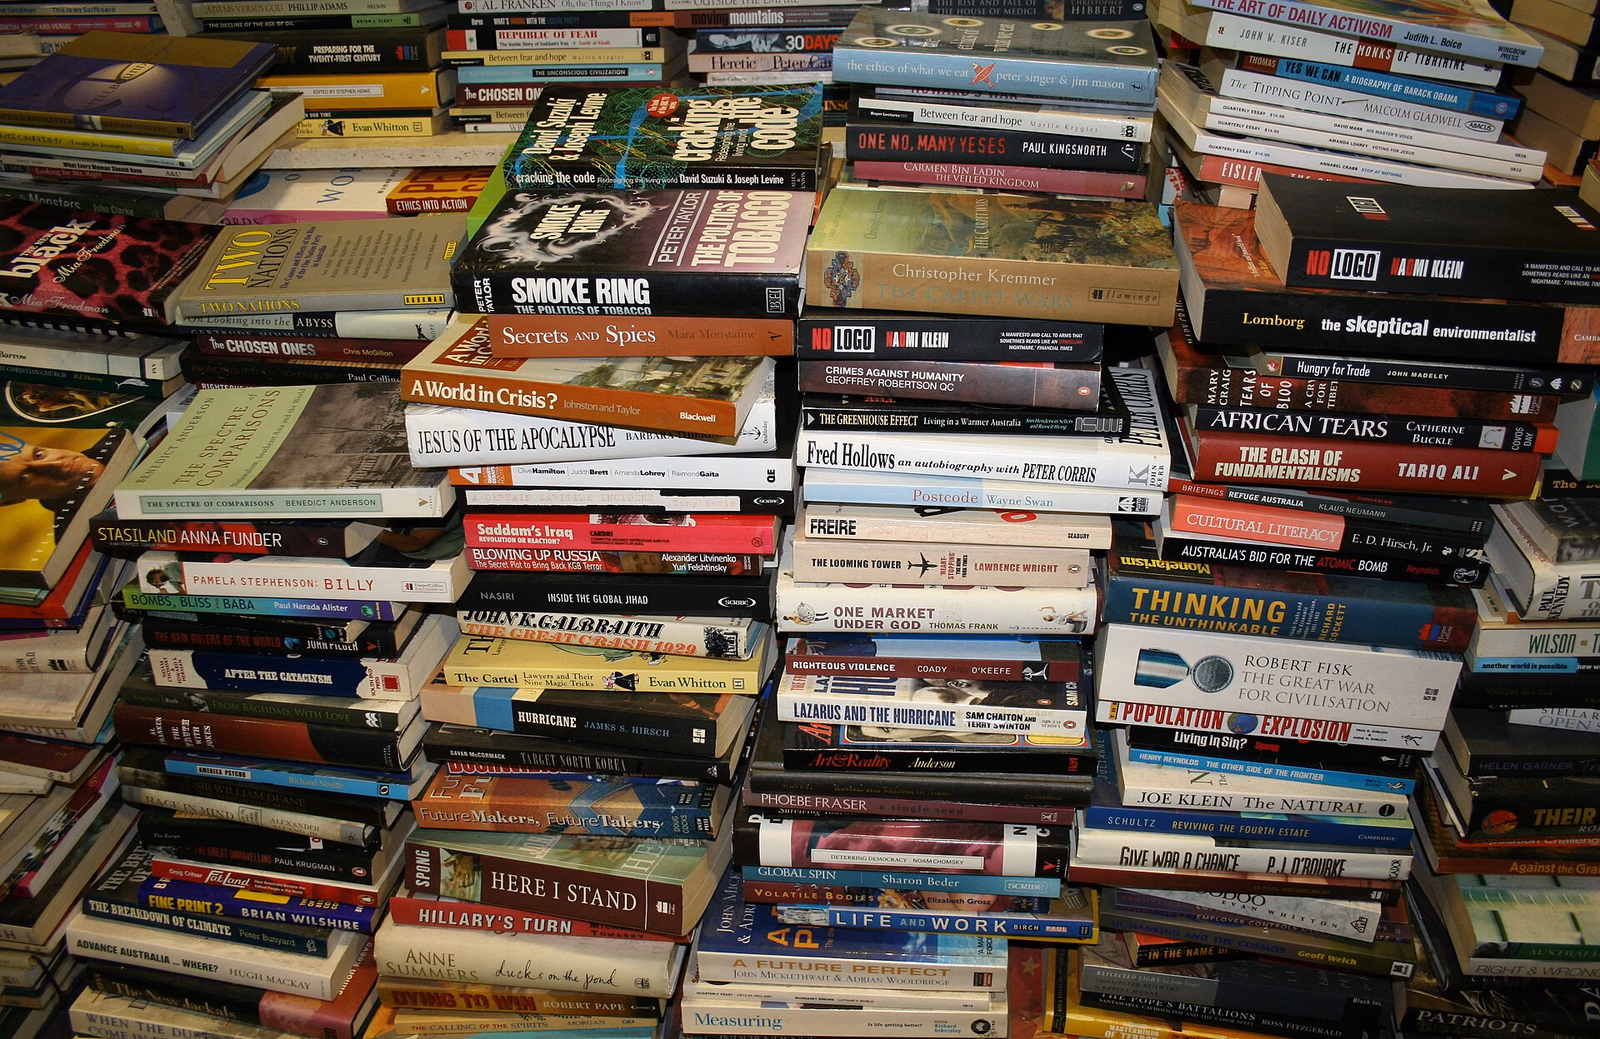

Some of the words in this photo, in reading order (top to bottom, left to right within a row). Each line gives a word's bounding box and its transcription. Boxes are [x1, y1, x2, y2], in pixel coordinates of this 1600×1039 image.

[289, 2, 317, 12] PHILLIP
[319, 3, 347, 11] ADAMS
[499, 31, 545, 40] REPUBLIC
[549, 31, 566, 39] OF
[571, 30, 598, 39] FEAR
[308, 54, 352, 62] TWENTY-FIRST
[353, 54, 381, 62] CENTURY
[313, 46, 348, 54] PREPARING
[349, 45, 362, 54] FOR
[363, 45, 375, 53] THE
[847, 61, 863, 72] the
[866, 62, 892, 73] ethics
[896, 62, 908, 73] of
[911, 65, 934, 74] what
[938, 68, 952, 76] we
[955, 68, 969, 77] eat
[996, 71, 1022, 84] peter
[1026, 72, 1056, 85] singer
[1059, 74, 1068, 84] &
[1071, 75, 1088, 88] jim
[1091, 79, 1124, 88] mason
[1363, 103, 1410, 116] MALCOLM
[1413, 110, 1461, 127] GLADWELL
[859, 134, 885, 148] ONE
[891, 134, 914, 150] NO,
[918, 137, 955, 151] MANY
[959, 139, 1005, 153] YESES
[1022, 142, 1046, 153] PAUL
[1050, 143, 1107, 156] KINGSNORTH
[516, 172, 553, 185] cracking
[556, 172, 570, 183] the
[573, 172, 595, 183] code
[396, 200, 420, 212] ETHICS
[423, 200, 437, 210] INTO
[440, 199, 467, 210] ACTION
[892, 264, 983, 283] Christopher
[988, 269, 1057, 286] Kremmer
[512, 278, 590, 304] SMOKE
[597, 278, 650, 304] RING
[296, 314, 333, 328] ABYSS
[1243, 313, 1305, 329] Lomborg
[1321, 319, 1340, 331] the
[1346, 317, 1428, 338] skeptical
[1433, 327, 1536, 343] environmentalist
[503, 327, 568, 345] Secrets
[574, 331, 599, 341] AND
[606, 325, 656, 347] Spies
[812, 328, 831, 349] NO
[836, 328, 873, 350] LOGO
[886, 331, 918, 348] NAOMI
[922, 332, 949, 348] KLEIN
[210, 337, 224, 350] the
[226, 339, 278, 355] CHOSEN
[281, 341, 316, 356] ONES
[826, 366, 863, 377] CRIMES
[866, 368, 909, 379] AGAINST
[912, 371, 964, 382] HUMANITY
[1297, 362, 1329, 377] Hungry
[1332, 365, 1345, 377] for
[1346, 365, 1370, 377] Trade
[1411, 371, 1448, 380] MADELEY
[680, 412, 716, 422] Blackwell
[1211, 411, 1315, 432] AFRICAN
[1318, 417, 1387, 437] TEARS
[418, 431, 462, 455] JESUS
[464, 430, 483, 452] OF
[486, 429, 517, 451] THE
[520, 426, 615, 450] APOCALYPSE
[807, 441, 838, 465] Fred
[842, 442, 894, 469] Hollows
[1022, 462, 1056, 480] PETER
[1058, 465, 1096, 483] CORRIS
[1215, 462, 1361, 482] FUNDAMENTALISMS
[1398, 463, 1448, 479] TARIQ
[1452, 465, 1479, 480] ALI
[912, 489, 978, 503] Postcode
[986, 494, 1021, 506] Wayne
[1024, 497, 1053, 507] Swan
[98, 528, 177, 542] STASILAND
[181, 531, 220, 545] ANNA
[223, 532, 282, 547] FUNDER
[478, 524, 542, 537] Saddam's
[545, 527, 573, 540] Iraq
[1186, 513, 1265, 534] CULTURAL
[1270, 522, 1338, 544] LITERACY
[1352, 533, 1363, 544] E.
[1366, 535, 1379, 546] D.
[1381, 536, 1418, 552] Hirsch,
[1420, 540, 1433, 551] Jr.
[473, 549, 531, 561] BLOWING
[533, 550, 553, 560] UP
[556, 550, 601, 561] RUSSIA
[974, 563, 1020, 572] LAWRENCE
[1022, 564, 1058, 573] WRIGHT
[548, 593, 573, 602] INSIDE
[576, 594, 590, 603] THE
[593, 594, 622, 604] GLOBAL
[625, 595, 648, 604] JIHAD
[1131, 588, 1287, 623] THINKING
[1529, 634, 1575, 653] WILSON
[792, 661, 844, 671] RIGHTEOUS
[848, 663, 895, 672] VIOLENCE
[1245, 655, 1310, 673] ROBERT
[1316, 662, 1353, 676] FISK
[454, 672, 479, 682] The
[482, 674, 518, 684] Cartel
[518, 711, 576, 728] HURRICANE
[584, 721, 617, 731] JAMES
[620, 723, 628, 732] S.
[631, 725, 670, 737] HIRSCH
[1123, 702, 1224, 729] POPULATION
[1260, 715, 1352, 741] EXPLOSION
[761, 793, 811, 807] PHOEBE
[815, 796, 867, 811] FRASER
[1137, 792, 1172, 806] JOE
[1178, 794, 1233, 808] KLEIN
[1243, 796, 1275, 809] The
[1281, 799, 1367, 814] NATURAL
[1533, 808, 1596, 825] THEIR
[274, 857, 295, 867] PAUL
[298, 858, 335, 872] KRUGMAN
[416, 850, 430, 887] SPONG
[758, 867, 809, 879] GLOBAL
[813, 868, 836, 879] SPIN
[492, 871, 546, 897] HERE
[553, 879, 561, 898] I
[568, 882, 637, 911] STAND
[241, 908, 286, 921] BRIAN
[291, 914, 359, 930] WILSHIRE
[419, 909, 514, 929] HILLARY'S
[523, 918, 572, 933] TURN
[836, 912, 892, 928] LIFE
[900, 918, 926, 928] AND
[932, 917, 1007, 932] WORK
[733, 959, 747, 968] A
[757, 959, 842, 972] FUTURE
[853, 963, 951, 976] PERFECT
[1298, 951, 1327, 962] Geoff
[1329, 955, 1357, 966] Welch
[229, 968, 264, 981] HUGH
[266, 974, 310, 990] MACKAY
[543, 1002, 591, 1011] ROBERT
[695, 1013, 782, 1030] Measuring
[1416, 1011, 1538, 1035] PATRIOTS
